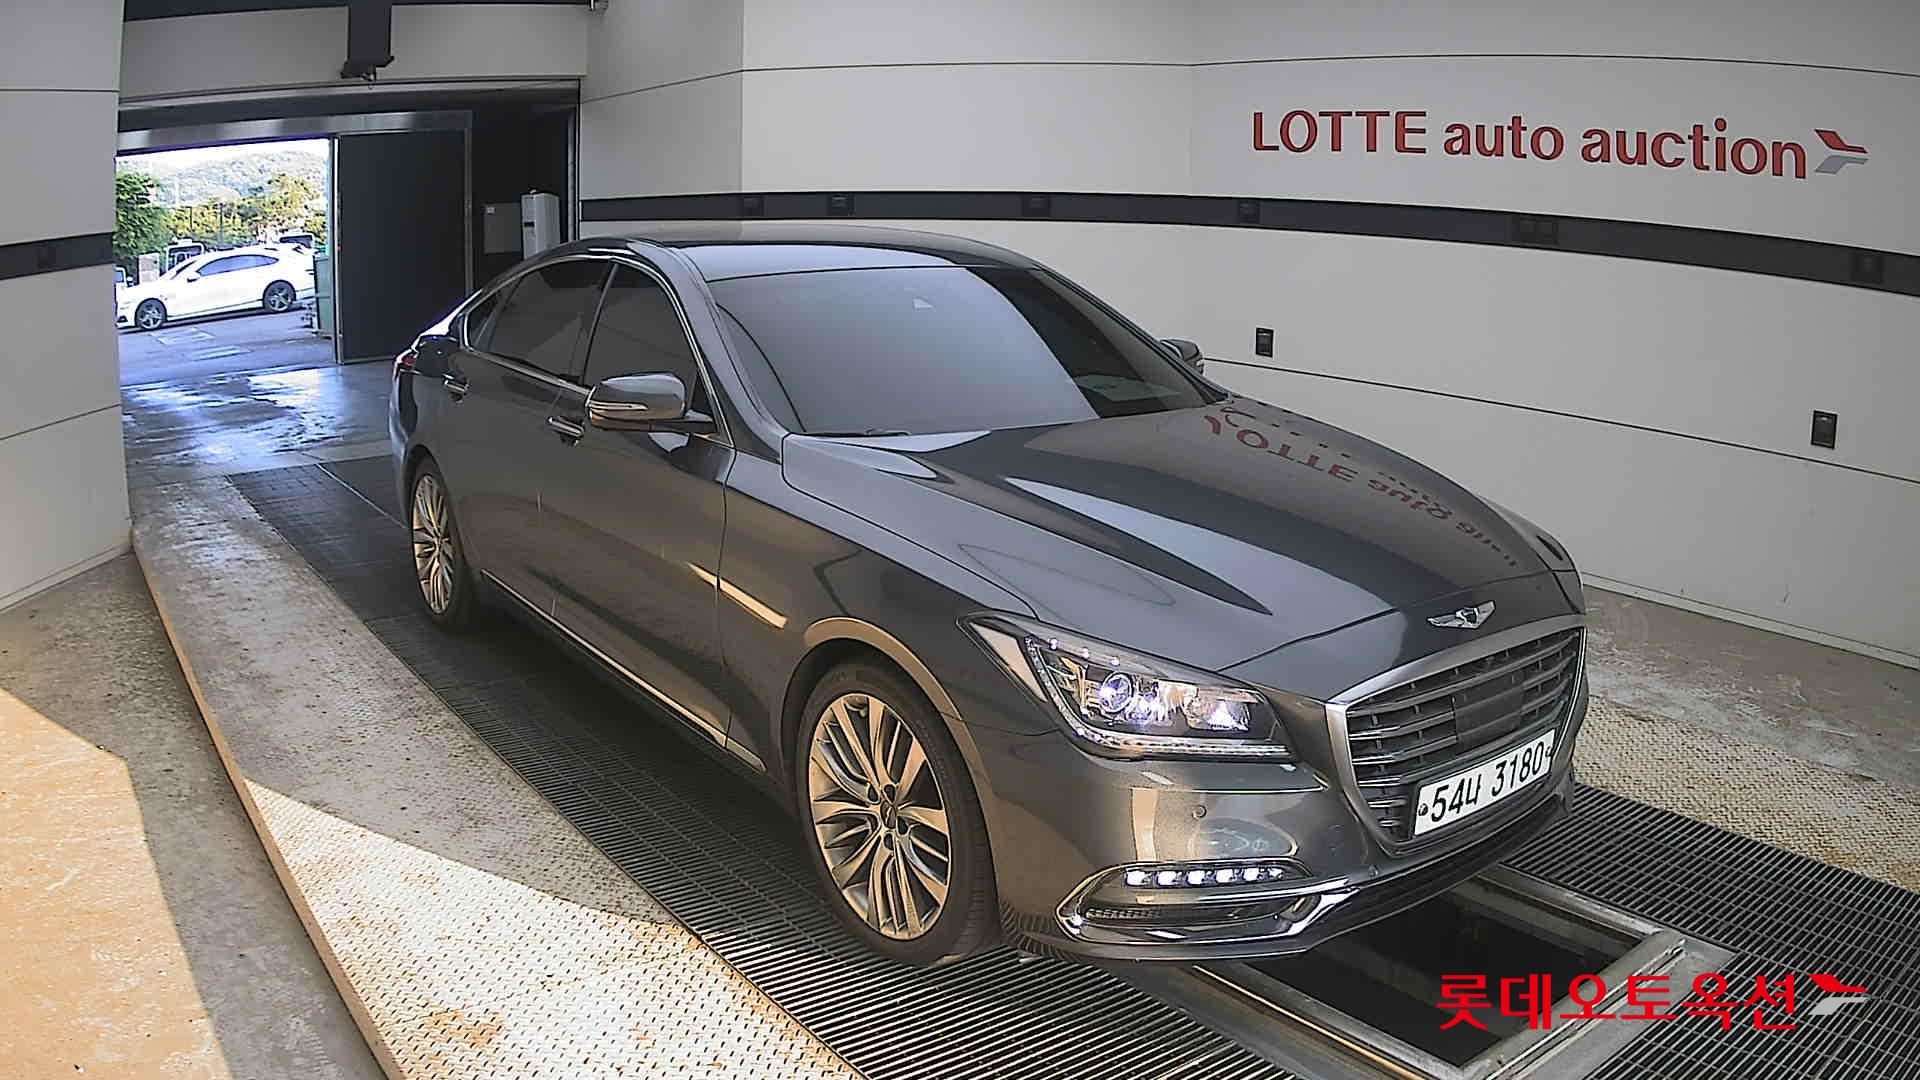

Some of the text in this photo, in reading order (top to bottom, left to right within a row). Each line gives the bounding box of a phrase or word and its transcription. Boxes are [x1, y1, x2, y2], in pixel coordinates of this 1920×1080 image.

[1253, 111, 1807, 180] LOTTE auto auction
[1431, 741, 1545, 823] 54나 3180
